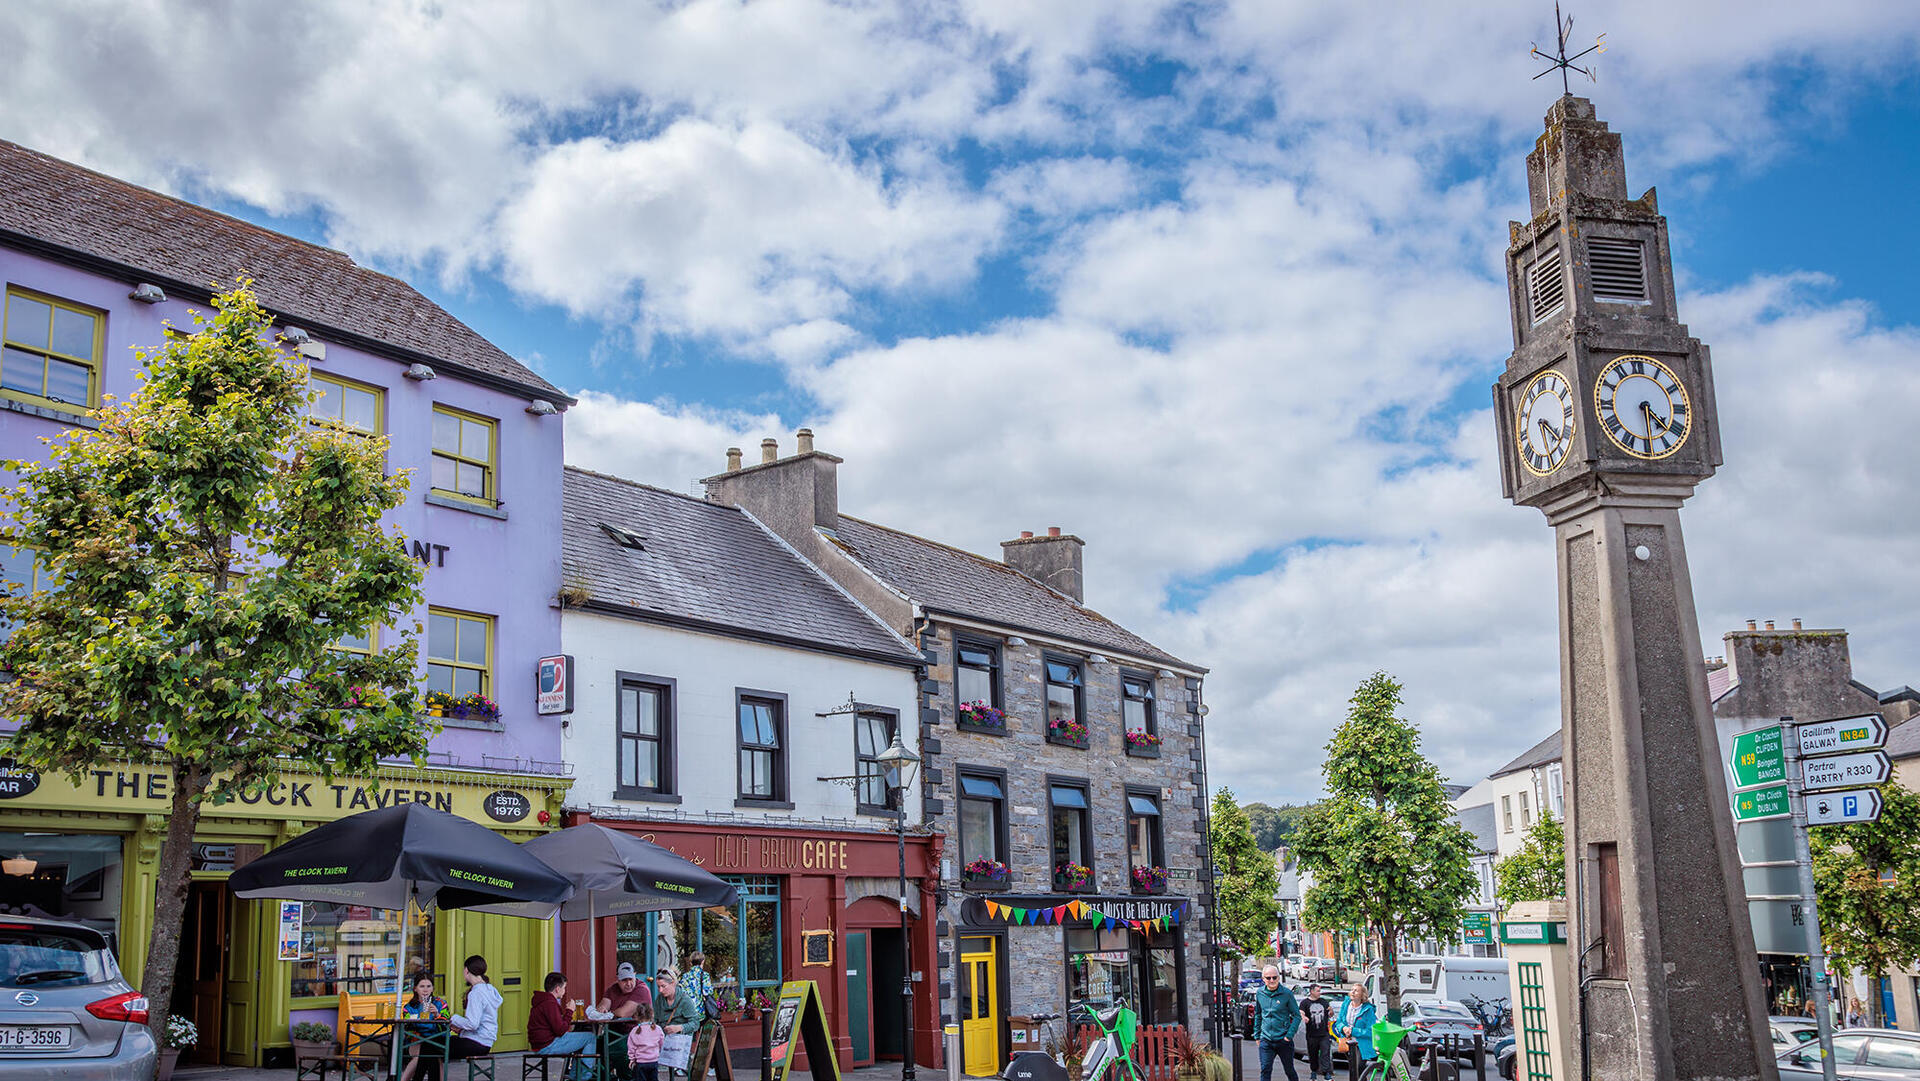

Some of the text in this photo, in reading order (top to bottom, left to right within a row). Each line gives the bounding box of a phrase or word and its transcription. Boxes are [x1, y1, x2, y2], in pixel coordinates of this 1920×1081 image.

[1756, 742, 1778, 754] CLIFDEN
[1803, 738, 1836, 750] GALWAY
[1758, 767, 1781, 780] BANGOR
[1810, 772, 1843, 784] PARTRY
[90, 771, 168, 799] THE
[330, 785, 452, 813] TAVERN
[494, 805, 521, 817] 1976
[1757, 802, 1779, 813] DUBLIN
[1846, 798, 1855, 815] P
[761, 838, 798, 869] BREW
[802, 840, 848, 869] CAFE
[284, 866, 348, 878] THE CLOCK TAVERN
[449, 868, 514, 889] THE CLOCK TAVERN
[655, 880, 695, 894] THE CLOCK TAVERN
[1103, 901, 1124, 920] MUST
[1126, 902, 1135, 919] BE
[1137, 901, 1150, 918] THE
[1151, 901, 1172, 918] PLACE
